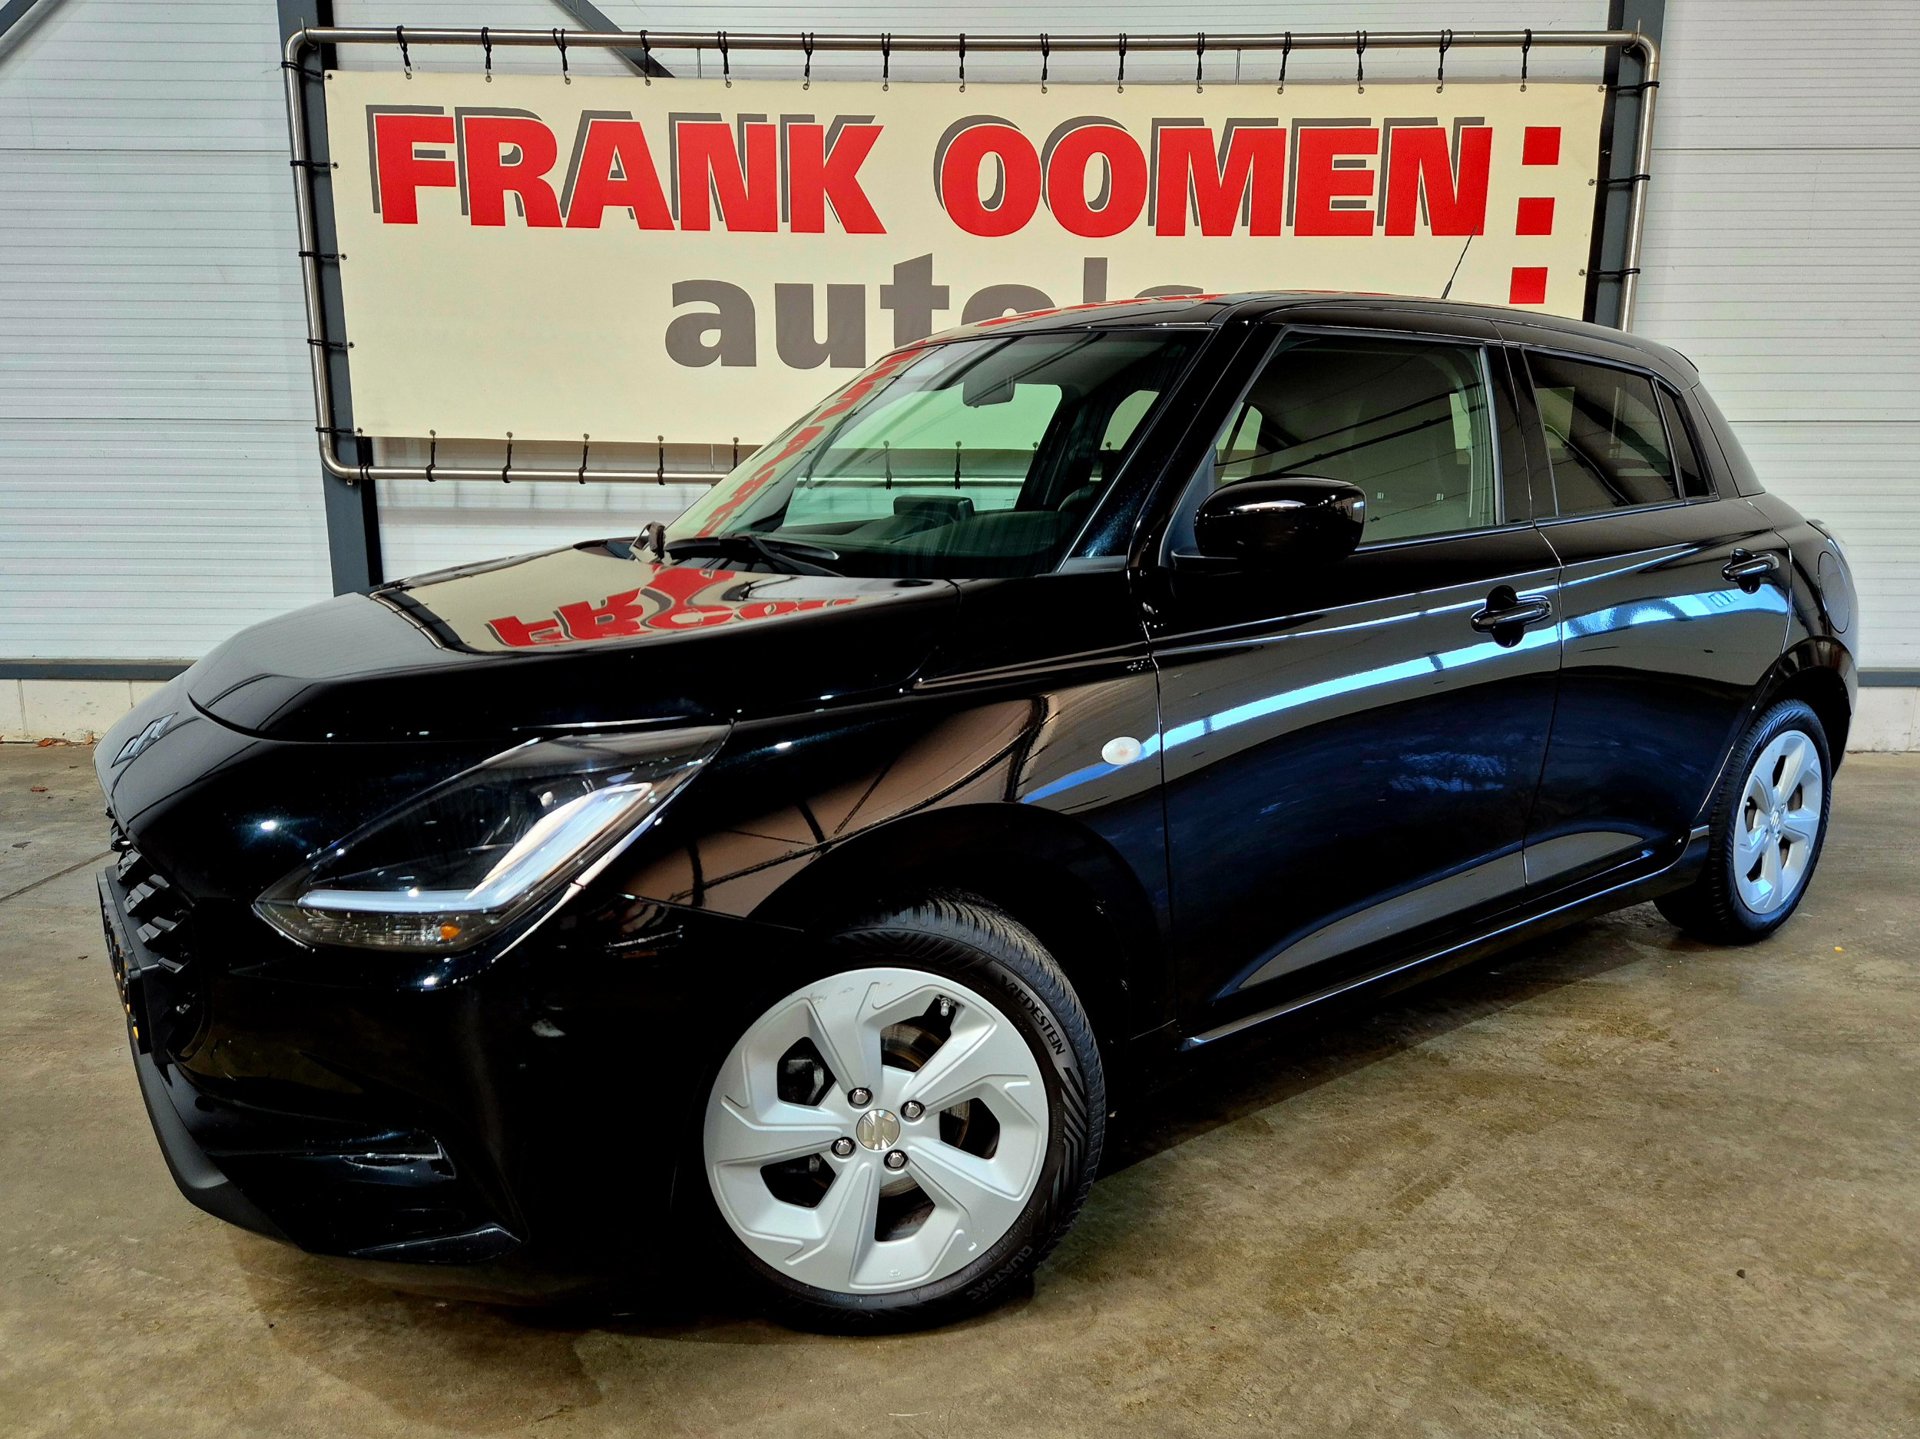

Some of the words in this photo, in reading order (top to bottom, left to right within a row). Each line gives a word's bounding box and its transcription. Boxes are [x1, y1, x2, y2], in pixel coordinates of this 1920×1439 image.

[366, 105, 887, 234] FRANK
[934, 115, 1493, 237] OOMEN
[1001, 974, 1066, 1056] VREDESTEIN
